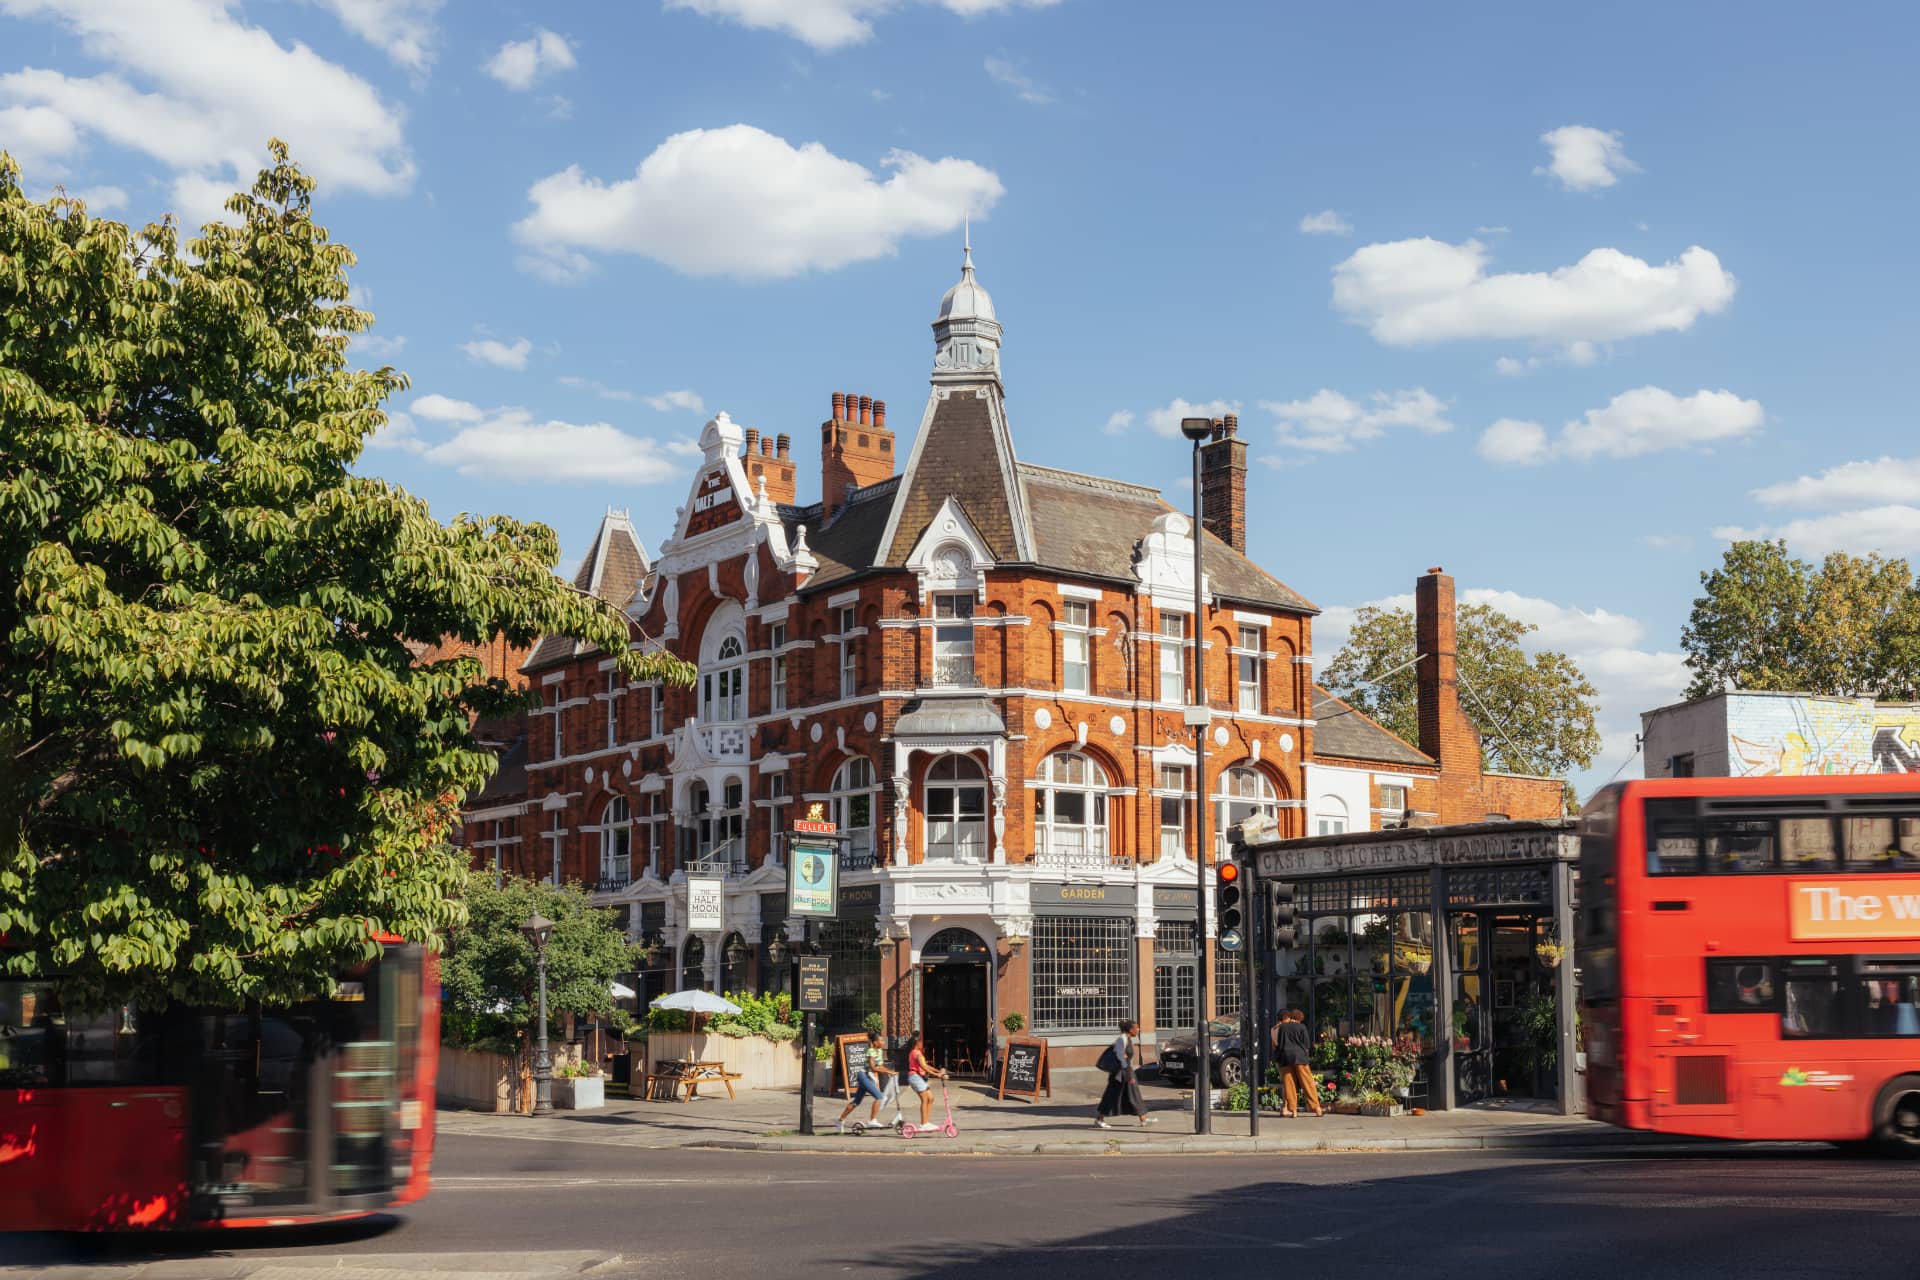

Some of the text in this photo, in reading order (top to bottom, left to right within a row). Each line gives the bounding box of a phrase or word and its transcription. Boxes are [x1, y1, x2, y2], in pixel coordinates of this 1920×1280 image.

[694, 494, 714, 512] HALF
[1263, 843, 1419, 870] CASH BUTCHERS
[694, 895, 717, 903] HALF
[1061, 888, 1105, 899] GARDEN
[692, 904, 719, 913] MOON
[1799, 887, 1882, 920] The
